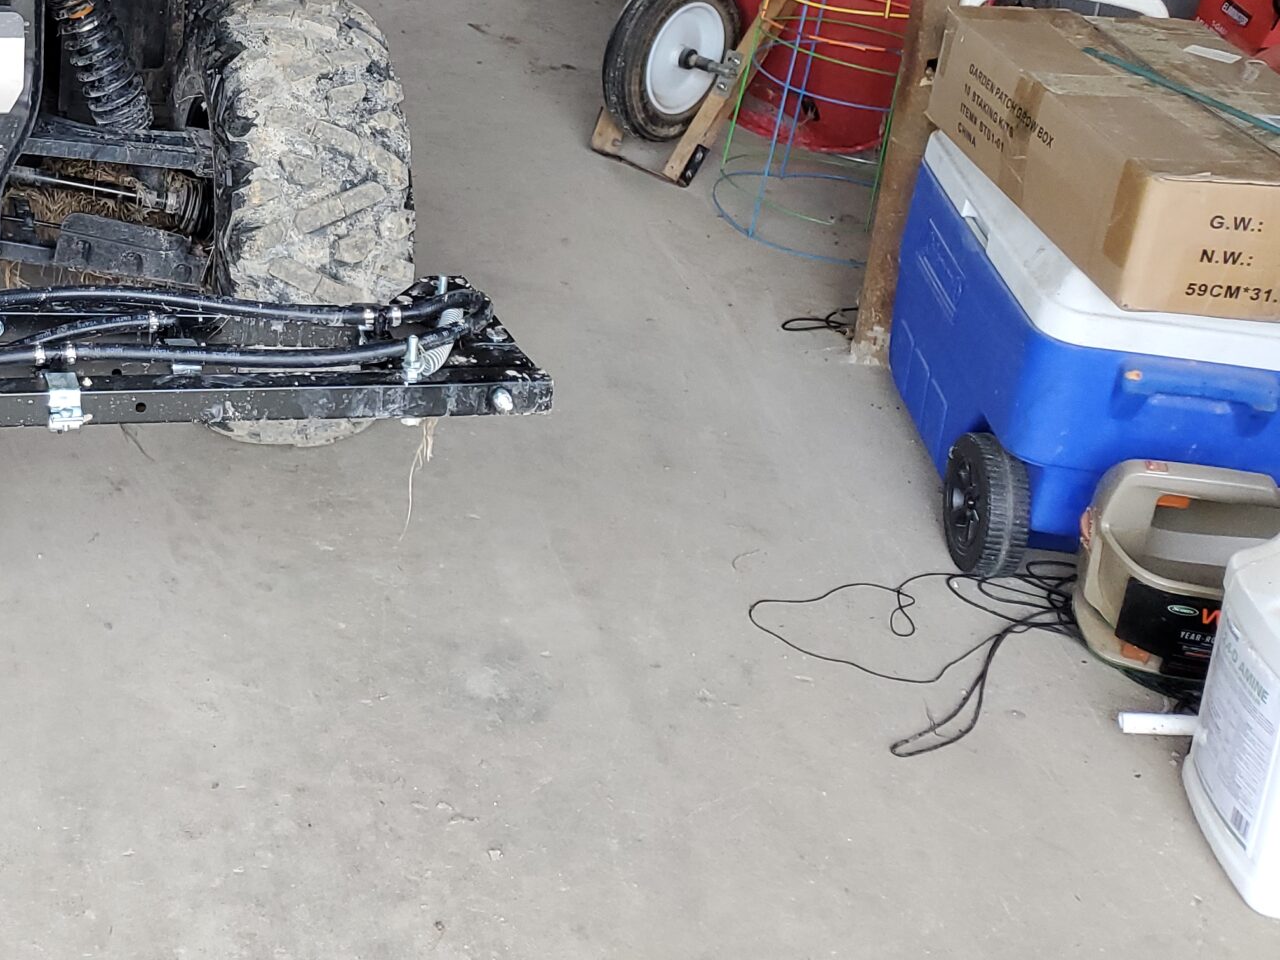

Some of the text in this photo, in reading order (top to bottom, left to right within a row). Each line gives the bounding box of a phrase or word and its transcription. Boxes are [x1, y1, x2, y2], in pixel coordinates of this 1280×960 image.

[968, 63, 1055, 149] GARDEN PATCH GROW BOX
[971, 91, 999, 123] STAKING
[957, 122, 976, 147] CHINA
[1209, 215, 1263, 232] G.W.:
[1199, 248, 1253, 266] N.W.:
[1238, 662, 1269, 705] AMINE
